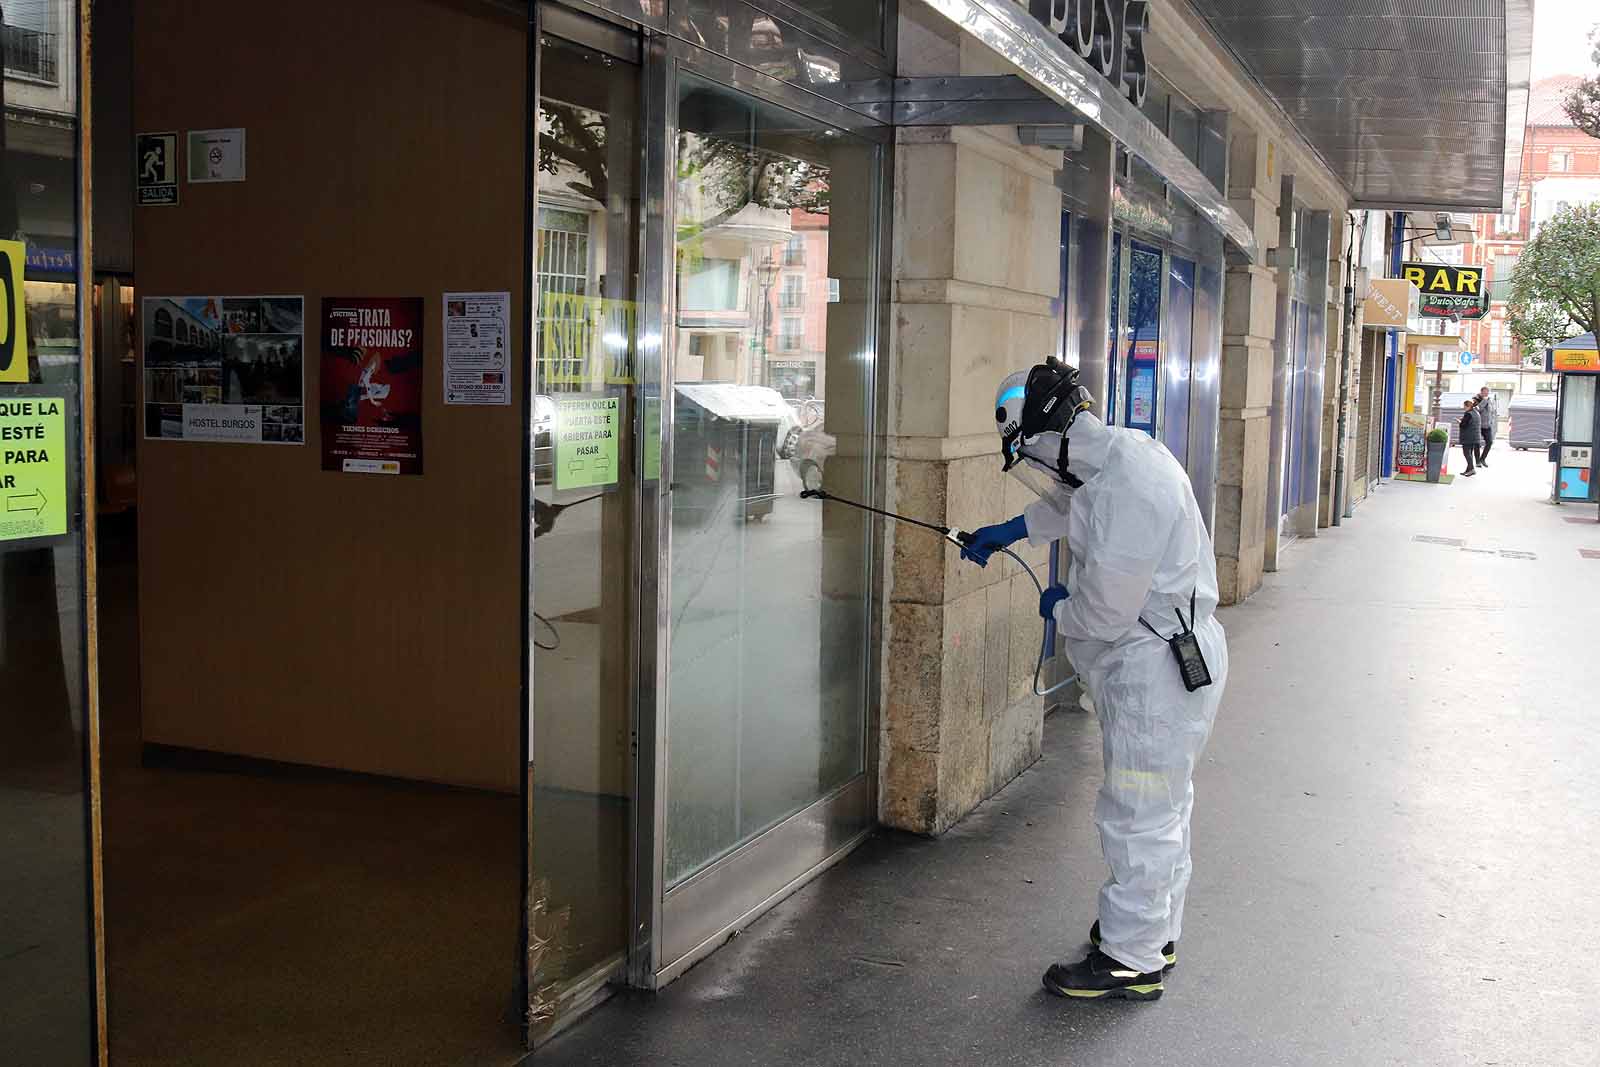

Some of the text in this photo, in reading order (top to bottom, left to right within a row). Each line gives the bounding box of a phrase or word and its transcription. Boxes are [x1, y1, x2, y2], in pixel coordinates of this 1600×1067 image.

[142, 187, 174, 198] SALIDA
[1405, 268, 1480, 293] BAR
[358, 308, 391, 327] TRATA
[331, 328, 344, 347] DE
[0, 402, 59, 416] QUE LA
[592, 401, 606, 409] QUE
[608, 401, 617, 409] LA
[189, 418, 256, 429] HOSTEL BURGOS
[2, 422, 45, 440] ESTÉ
[594, 429, 612, 439] PARA
[5, 450, 49, 464] PARA
[576, 445, 599, 456] PASAR
